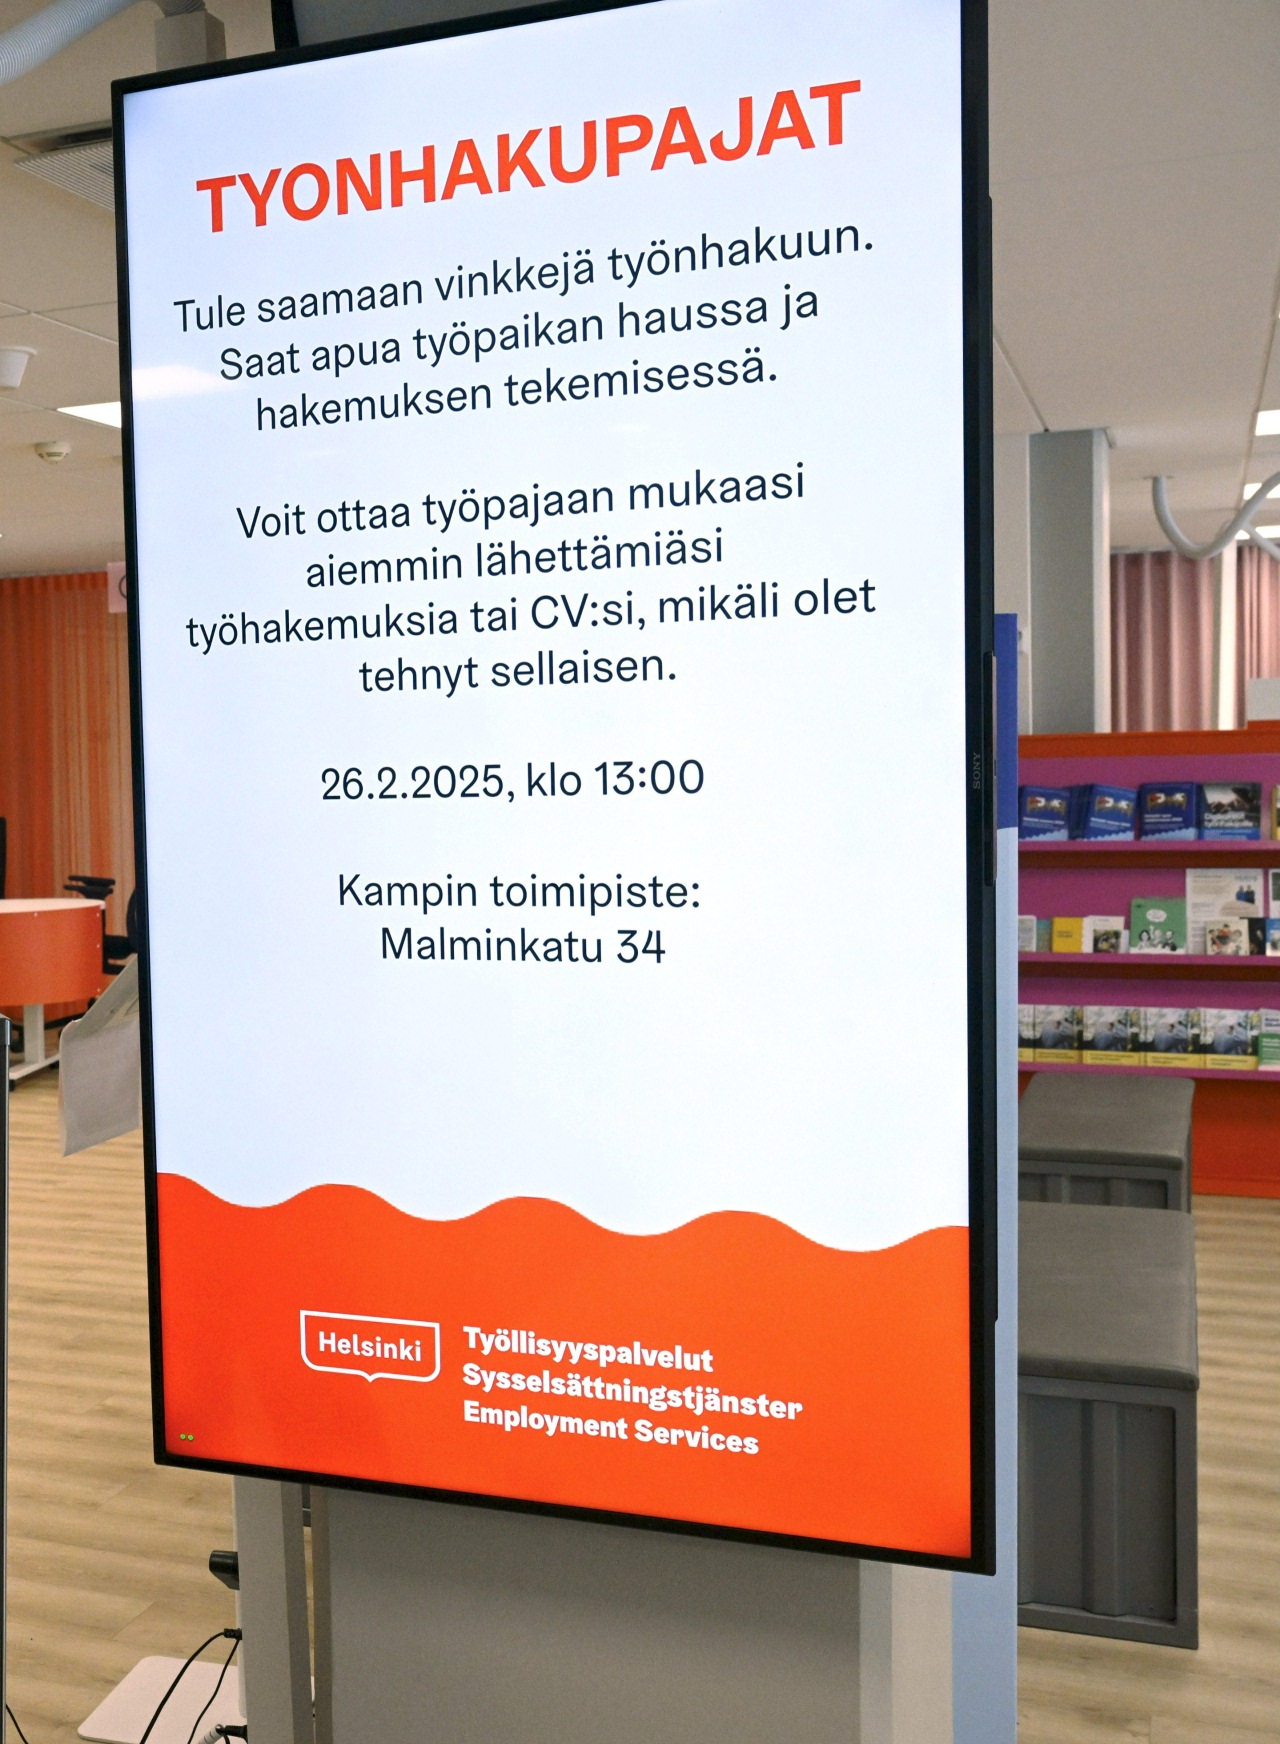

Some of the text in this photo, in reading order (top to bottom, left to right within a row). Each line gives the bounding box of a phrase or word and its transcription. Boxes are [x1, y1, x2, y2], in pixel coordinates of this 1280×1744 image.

[195, 79, 862, 234] TYONHAKUPAJAT
[173, 226, 872, 332] Tule saamaan vinkkejä työnhakuun.
[221, 284, 817, 380] Saat apua työpaikan haussa ja
[257, 347, 776, 430] hakemuksen tekemisessä.
[236, 462, 803, 538] Voit ottaa työpajaan mukaasi
[307, 527, 722, 587] aiemmin lähettämiäsi
[186, 578, 876, 655] työhakemuksia tai CV:si, mikäli olet
[359, 650, 675, 698] tehnyt sellaisen.
[322, 759, 703, 803] 26.2.2025, klo 13:00
[973, 752, 981, 789] SONY
[339, 874, 699, 916] Kampin toimipiste:
[382, 927, 665, 963] Malminkatu 34
[319, 1331, 421, 1361] Helsinki
[463, 1326, 713, 1372] Työllisyyspalvelut
[463, 1363, 803, 1419] Sysselsättningstjänster
[463, 1400, 760, 1454] Employment Services
